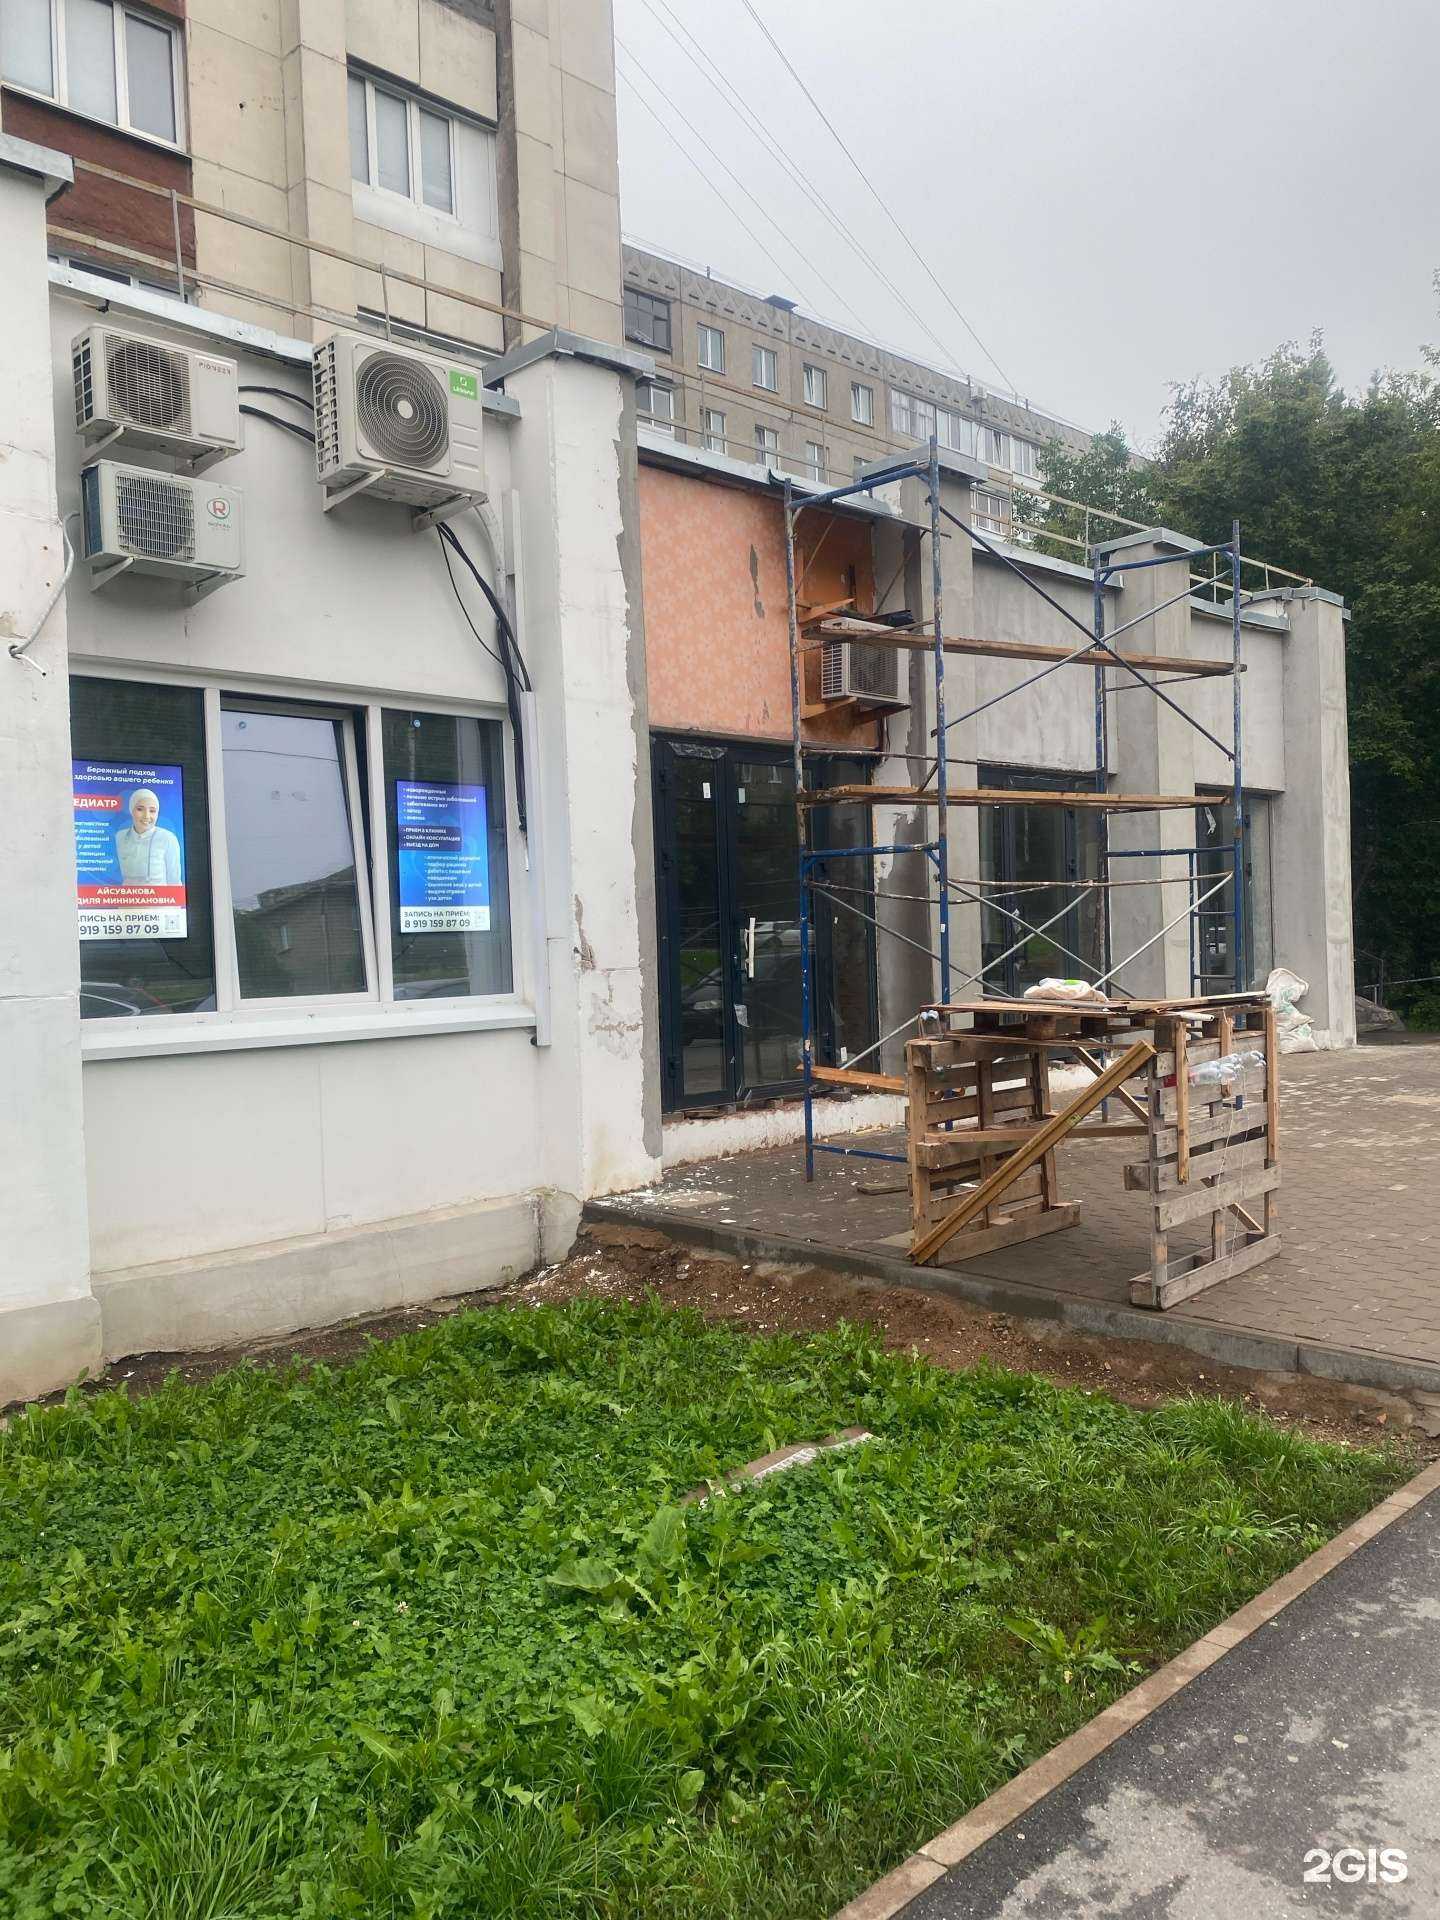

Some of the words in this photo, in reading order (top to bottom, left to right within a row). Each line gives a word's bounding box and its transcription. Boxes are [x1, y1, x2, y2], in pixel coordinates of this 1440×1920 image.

[198, 361, 231, 374] PIONEER
[212, 500, 226, 515] R
[87, 766, 127, 775] Бережный
[129, 768, 156, 777] подход
[74, 774, 112, 782] здоровью
[142, 777, 174, 785] ребенка
[73, 798, 118, 808] ЕДИАТР
[78, 914, 106, 922] ПИСЬ
[404, 920, 411, 928] 8
[413, 919, 428, 928] 919
[430, 919, 444, 928] 159
[446, 919, 457, 928] 87
[460, 919, 471, 927] 09
[80, 925, 99, 935] 919
[103, 925, 122, 934] 159
[126, 924, 140, 934] 87
[144, 924, 160, 934] 09
